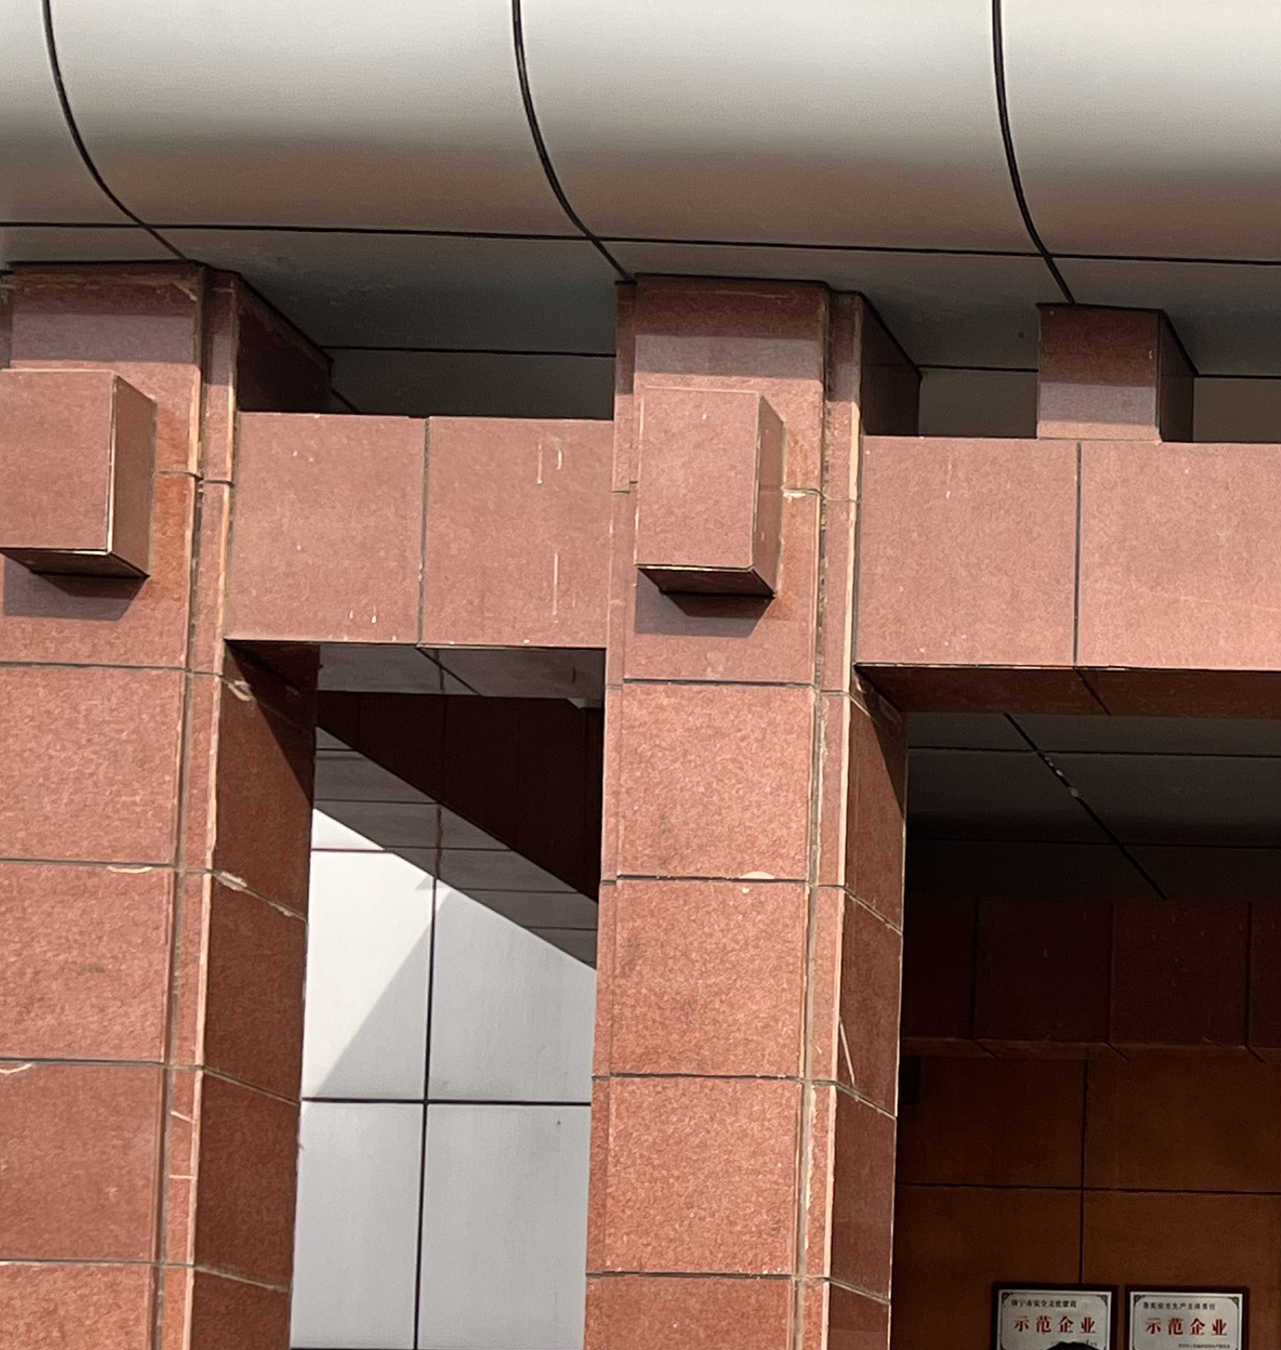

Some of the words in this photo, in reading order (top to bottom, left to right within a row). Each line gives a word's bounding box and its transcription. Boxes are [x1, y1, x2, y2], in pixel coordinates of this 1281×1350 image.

[1014, 1315, 1096, 1333] 示范企业
[1145, 1317, 1228, 1336] 示范企业
